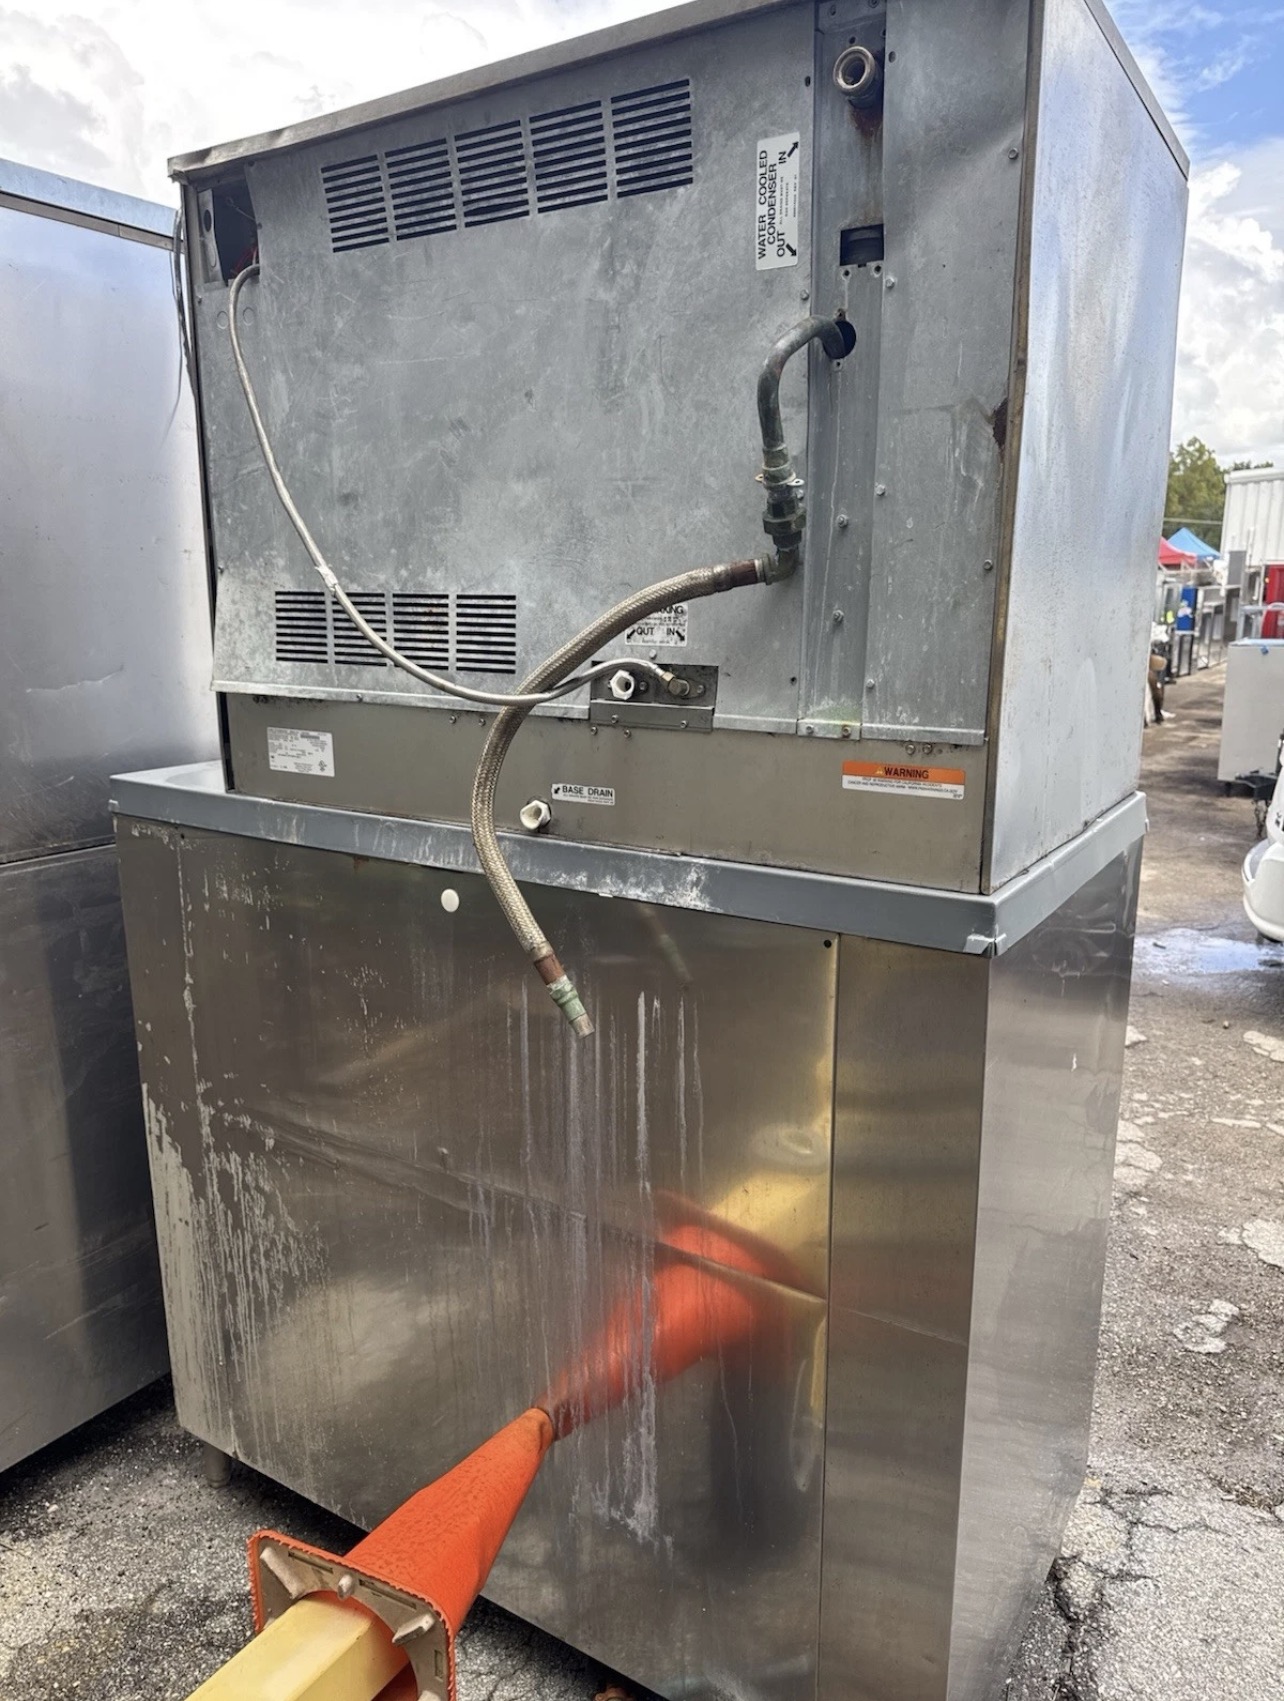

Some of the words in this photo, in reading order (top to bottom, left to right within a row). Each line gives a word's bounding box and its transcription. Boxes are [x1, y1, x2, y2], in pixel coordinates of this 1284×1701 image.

[778, 151, 787, 165] IN
[758, 150, 768, 205] COOLED
[767, 163, 777, 245] CONDENSER
[758, 214, 766, 260] WATER
[776, 230, 786, 257] OUT
[884, 766, 929, 779] WARNING
[562, 785, 584, 795] BASE
[587, 787, 613, 797] DRAIN
